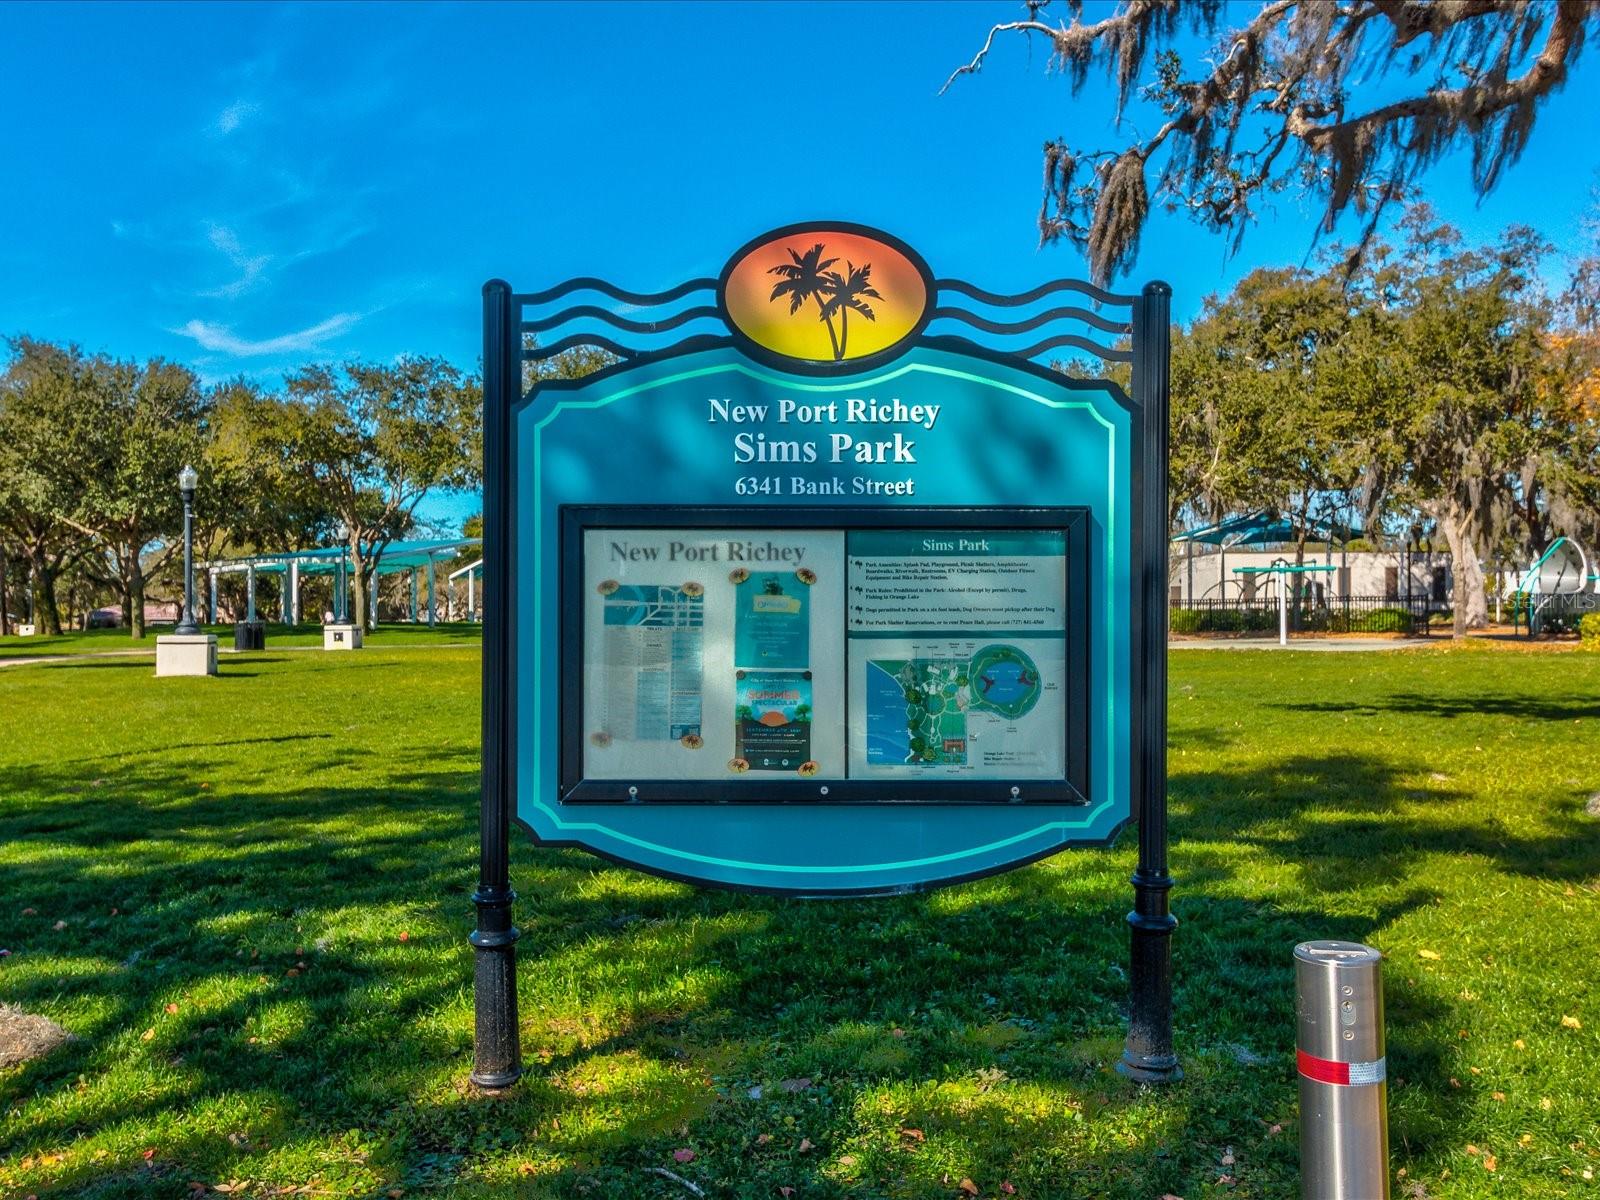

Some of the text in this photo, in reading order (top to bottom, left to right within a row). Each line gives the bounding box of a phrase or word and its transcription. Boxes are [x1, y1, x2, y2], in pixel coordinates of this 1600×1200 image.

[708, 399, 941, 430] New Port Richey
[734, 433, 917, 463] Sims Park
[735, 477, 915, 495] 6341 Bank Street
[610, 541, 807, 566] New Port Richey
[922, 539, 990, 551] Sims Park
